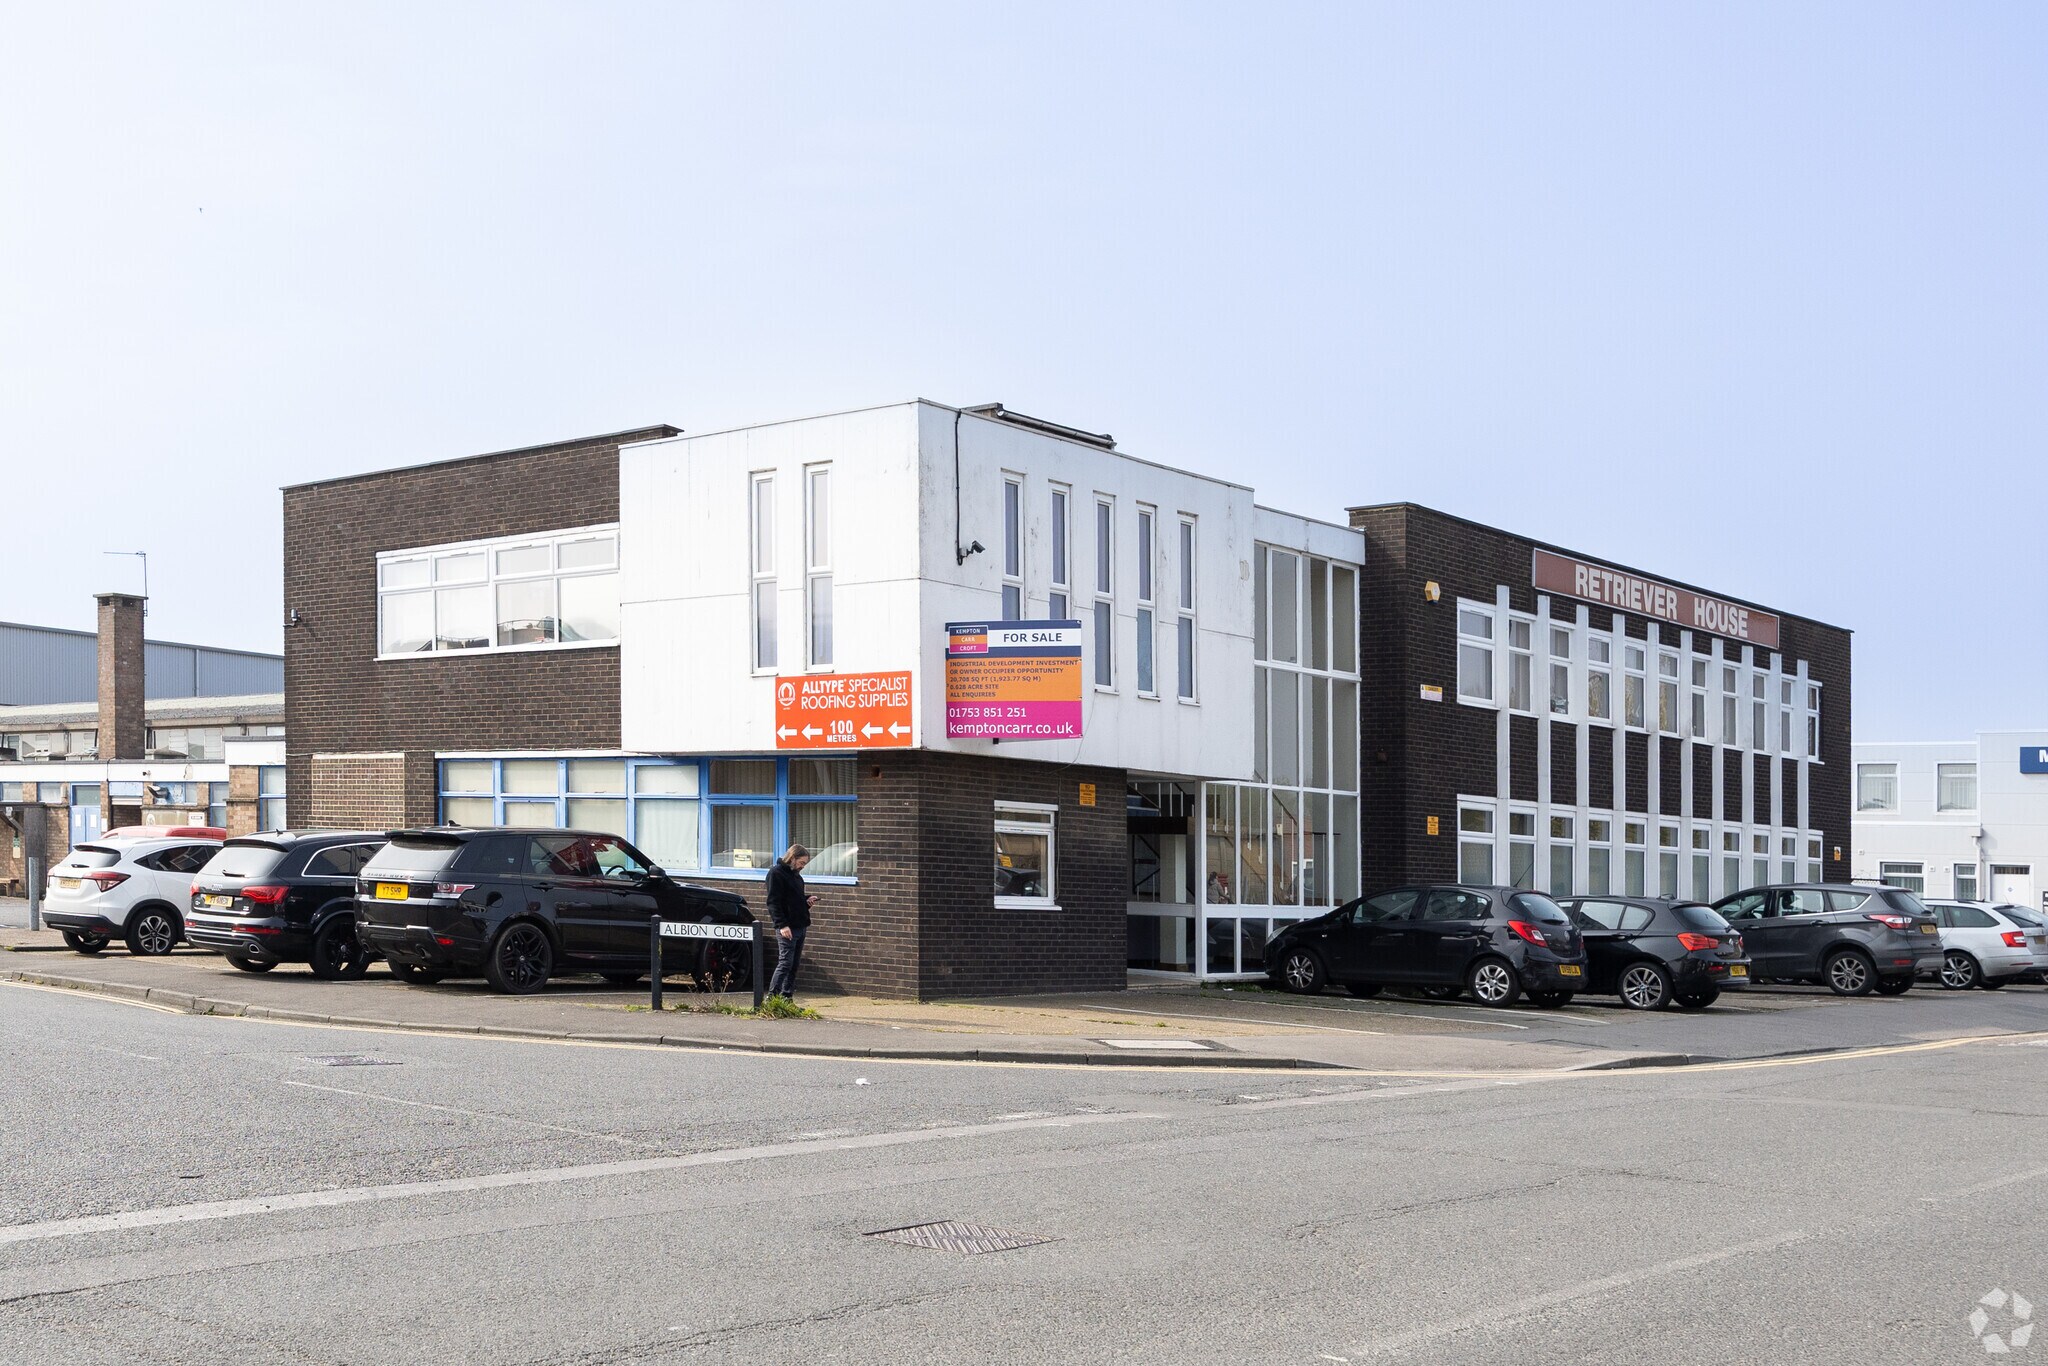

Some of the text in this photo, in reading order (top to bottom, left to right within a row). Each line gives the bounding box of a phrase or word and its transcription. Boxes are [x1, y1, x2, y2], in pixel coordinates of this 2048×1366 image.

[1575, 564, 1749, 639] RETRIEVER HOUSE
[1003, 632, 1063, 643] FOR SALE
[848, 677, 908, 692] SPECIALIST
[1021, 675, 1031, 683] SQ
[801, 692, 908, 710] ROOFING SUPPLIES
[949, 707, 1027, 718] 01753 851 251
[829, 720, 853, 735] 100
[949, 722, 1074, 736] kemptoncarr.co.uk
[826, 734, 857, 743] METRES
[664, 923, 750, 939] ALBION CLOSE
